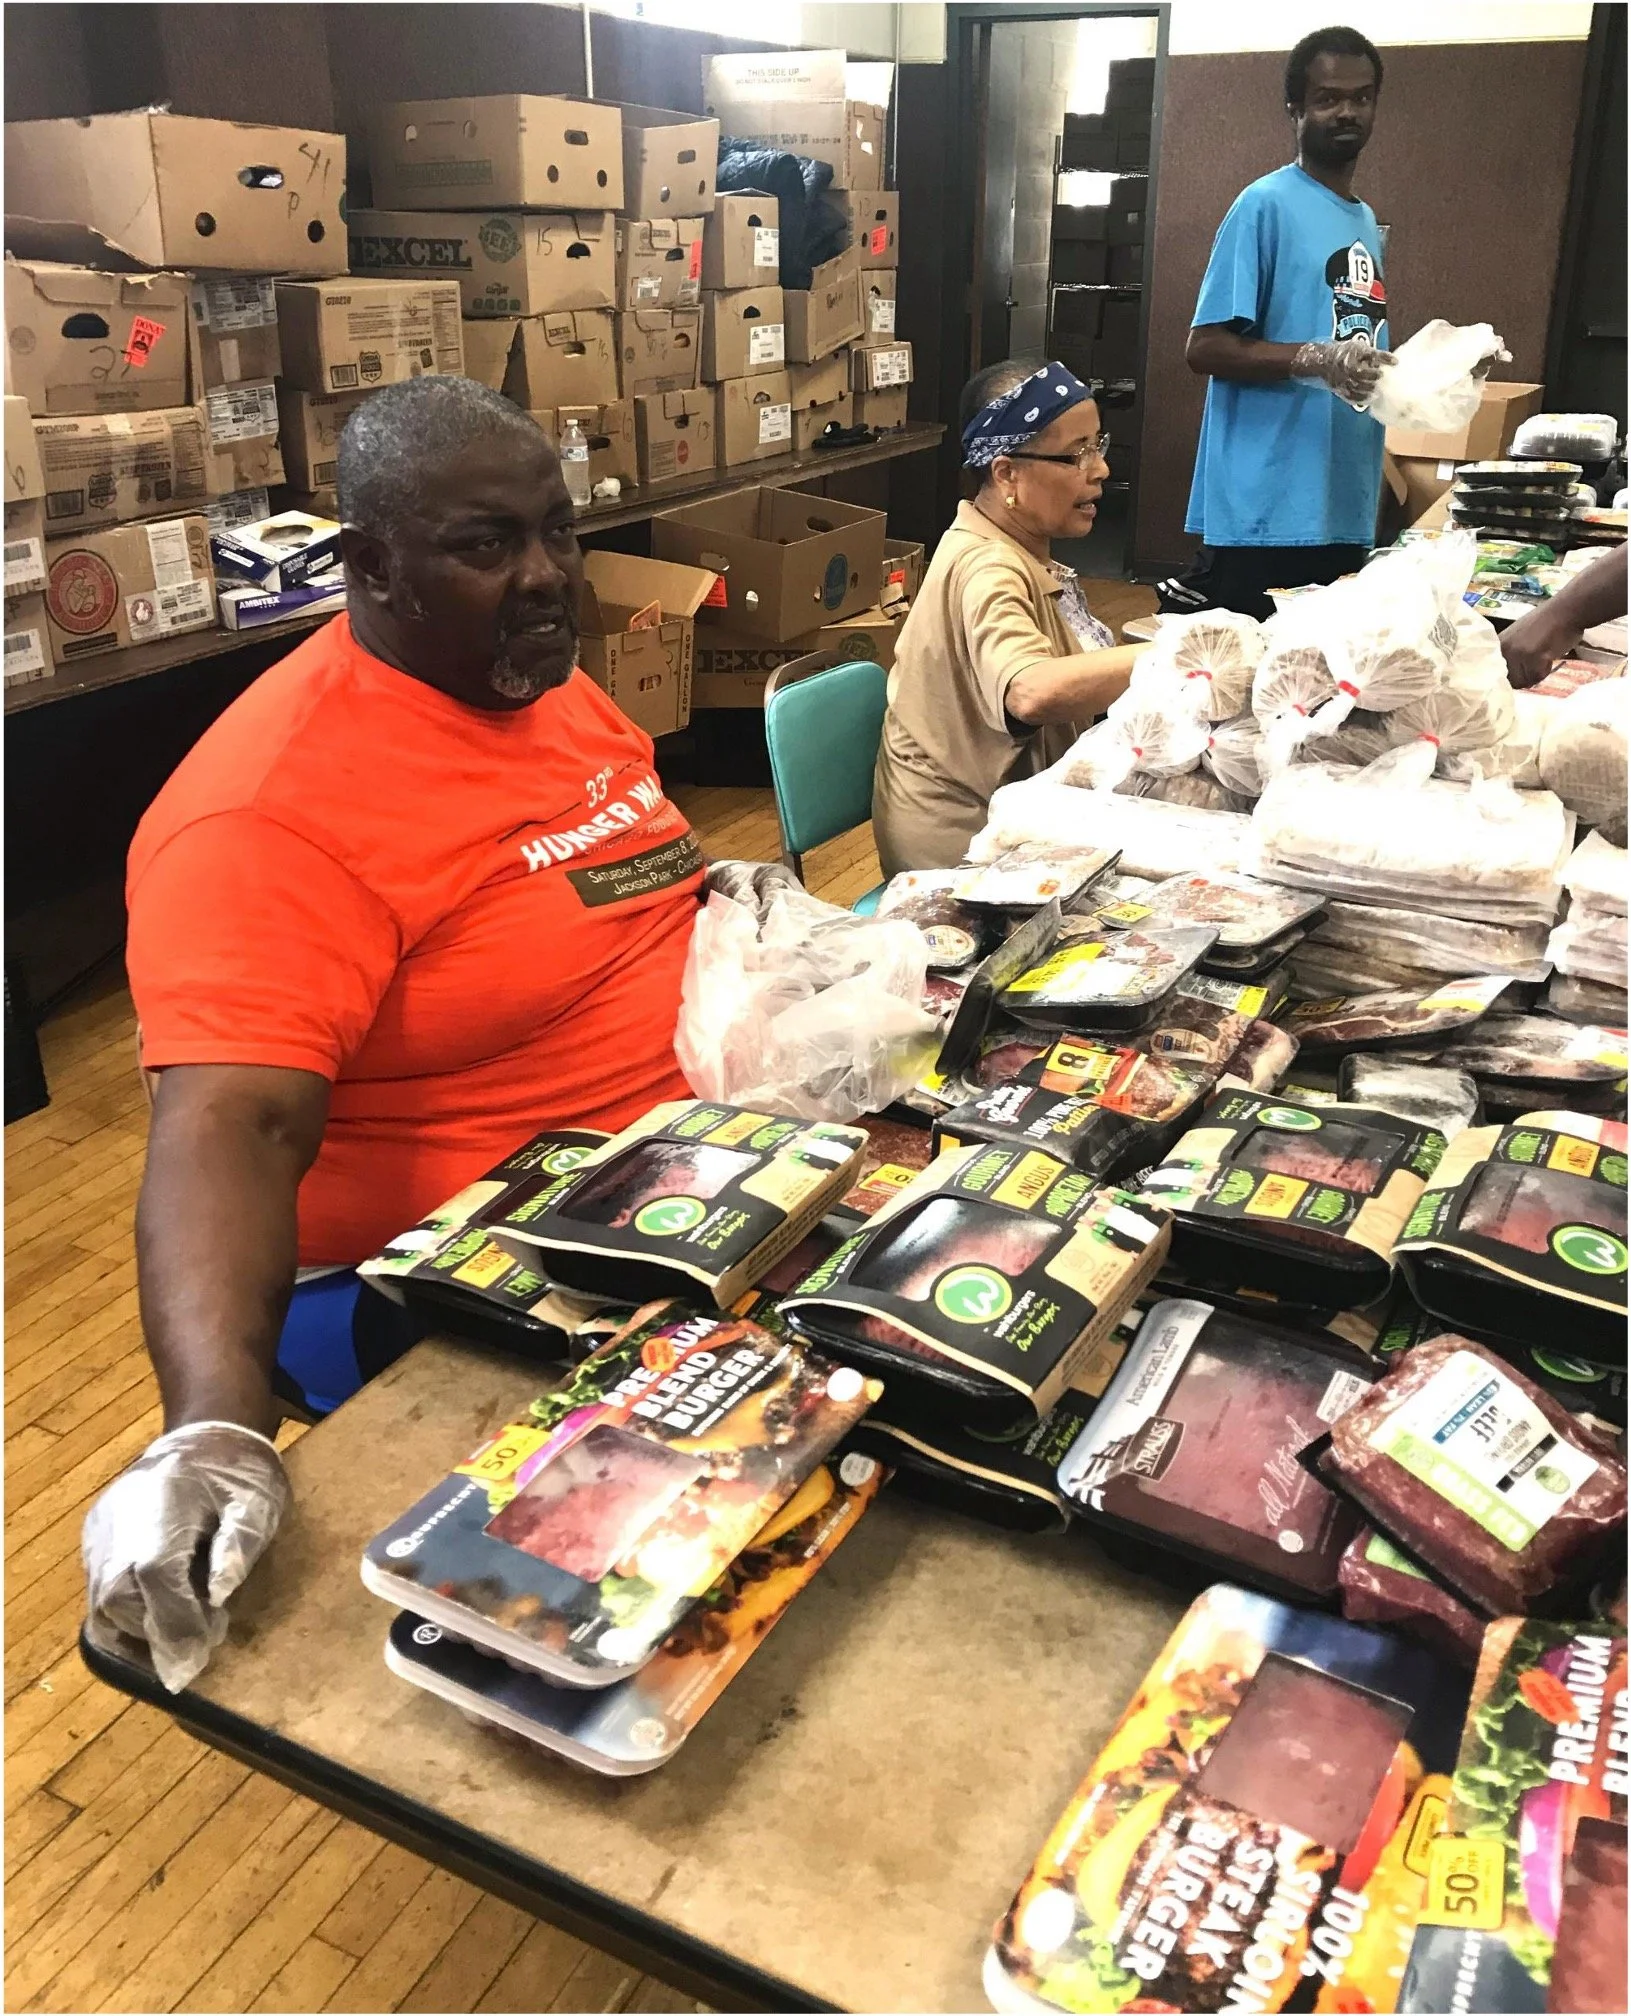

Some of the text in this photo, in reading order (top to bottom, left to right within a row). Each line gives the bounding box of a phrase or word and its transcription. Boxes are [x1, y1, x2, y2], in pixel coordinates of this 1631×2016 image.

[747, 67, 800, 77] THIS SIDE UP
[1355, 259, 1369, 283] 19
[239, 596, 281, 610] AMBITEX
[682, 663, 690, 713] GALLON
[520, 801, 641, 873] HUNGER
[587, 865, 637, 884] SATURDAY,
[634, 848, 681, 873] SEPTEMBER
[614, 876, 652, 896] JACKSON
[651, 867, 674, 885] PARK
[1057, 1051, 1091, 1070] 8
[961, 1151, 1013, 1191] GOURMET
[1016, 1163, 1056, 1200] ANGUS
[505, 1171, 583, 1223] SIGNATURE
[794, 1233, 867, 1295] SIGNATURE
[993, 1288, 1037, 1339] wahlburgers
[601, 1317, 720, 1409] PREIUM
[1016, 1336, 1030, 1353] Our
[1125, 1325, 1180, 1407] American Lamb
[632, 1350, 717, 1420] BLEND
[664, 1348, 765, 1431] BURGER
[1466, 1396, 1484, 1413] LEAN
[1133, 1420, 1177, 1475] STRAUSS
[1441, 1423, 1457, 1438] FAT
[481, 1447, 519, 1471] 50
[1257, 1476, 1291, 1526] all
[1118, 1821, 1233, 1981] BURGER
[1185, 1839, 1274, 1970] STEAK
[1300, 1887, 1369, 1987] 100%
